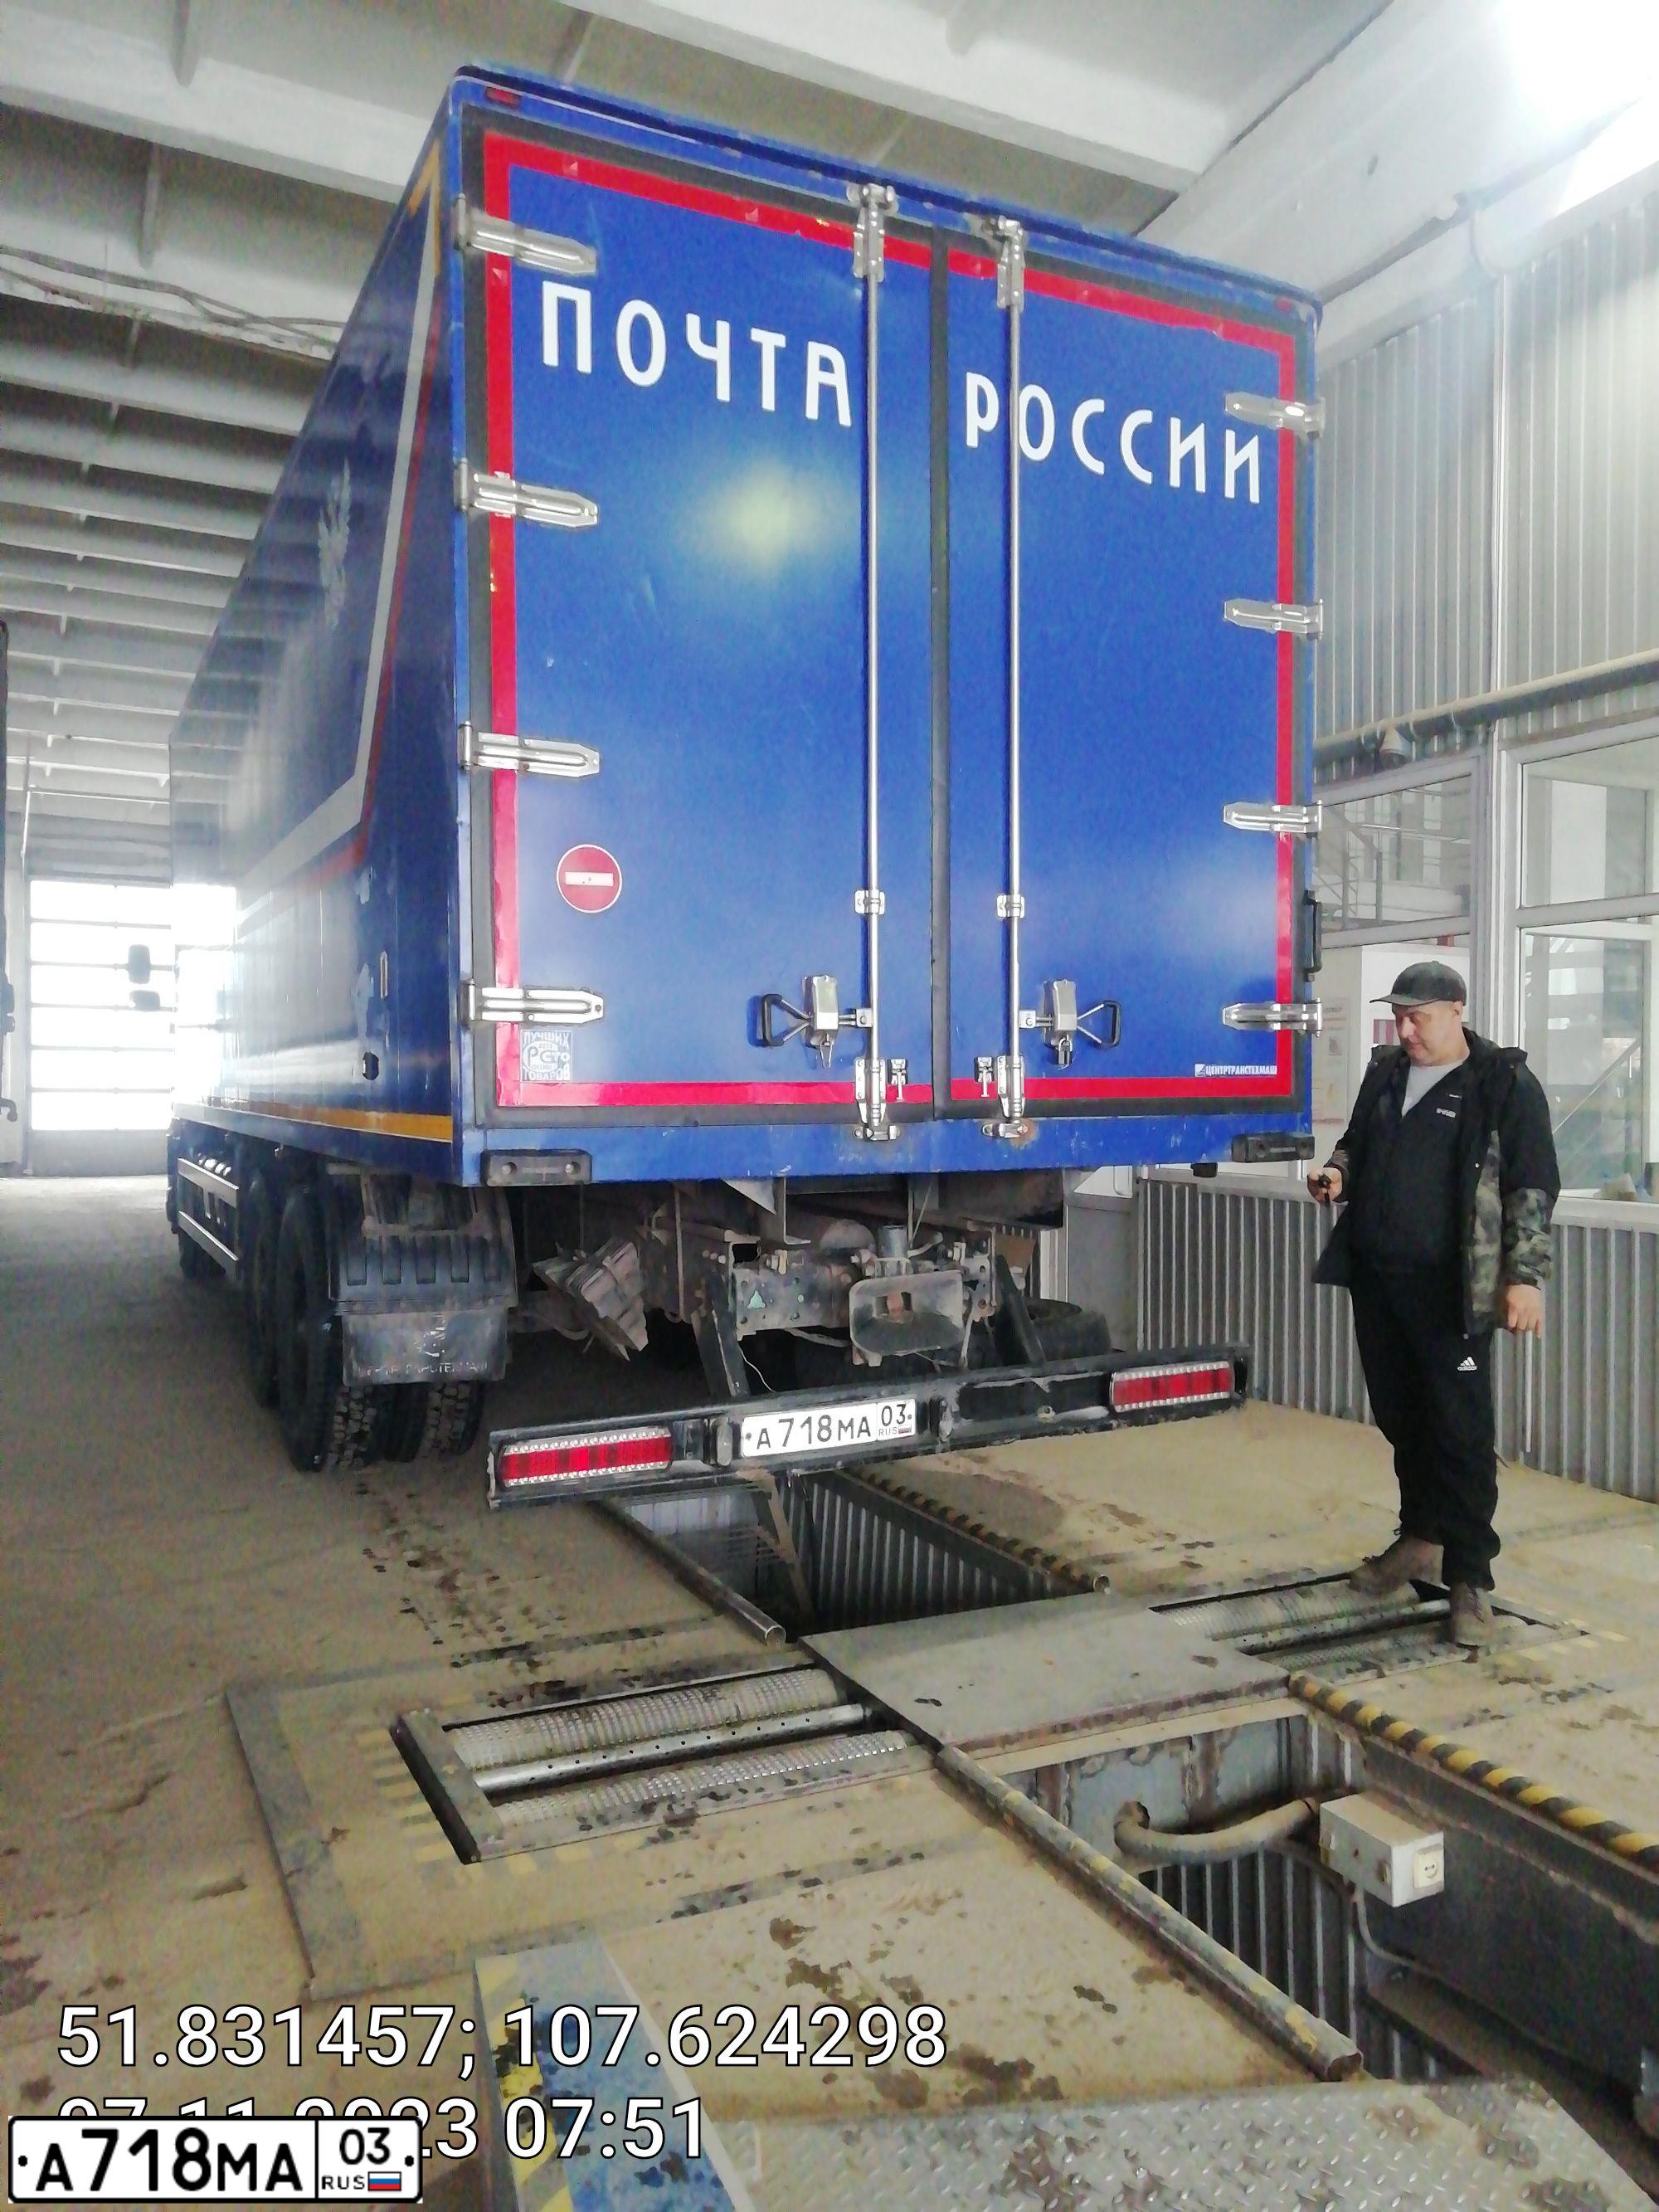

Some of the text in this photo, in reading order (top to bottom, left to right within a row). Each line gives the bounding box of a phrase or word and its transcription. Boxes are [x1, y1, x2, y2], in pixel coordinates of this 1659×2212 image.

[542, 280, 1261, 504] ПОЧТА РОССИИ
[523, 1031, 570, 1050] ЛУЧШИХ
[522, 1062, 571, 1081] ТОВАРОВ
[880, 1403, 907, 1427] 03
[878, 1427, 898, 1437] RUS
